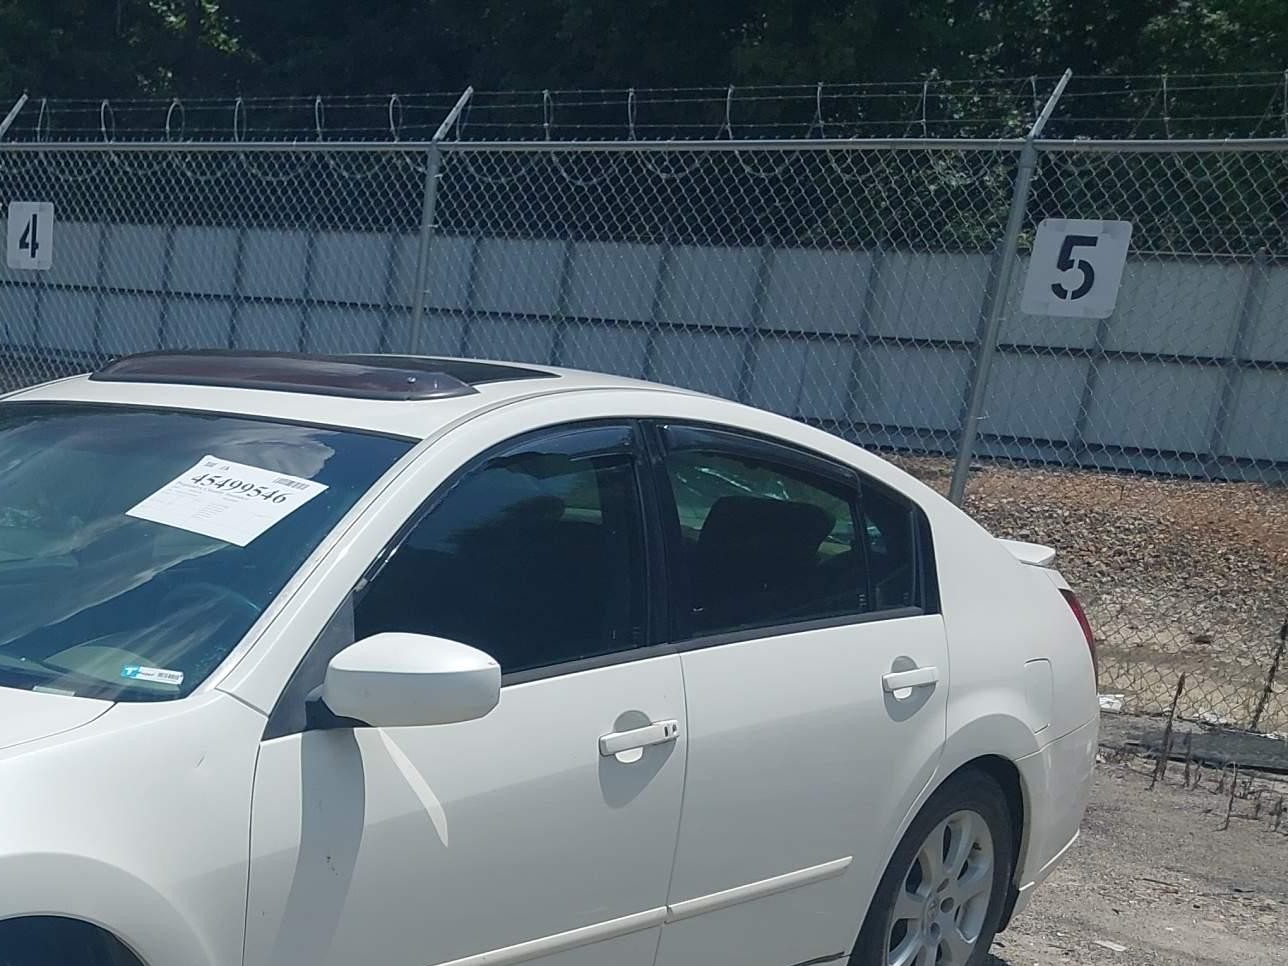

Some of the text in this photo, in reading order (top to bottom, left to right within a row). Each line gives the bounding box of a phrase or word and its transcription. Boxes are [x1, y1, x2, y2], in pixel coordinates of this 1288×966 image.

[18, 213, 40, 258] 4
[1051, 234, 1099, 300] 5
[191, 472, 289, 504] 45499546
